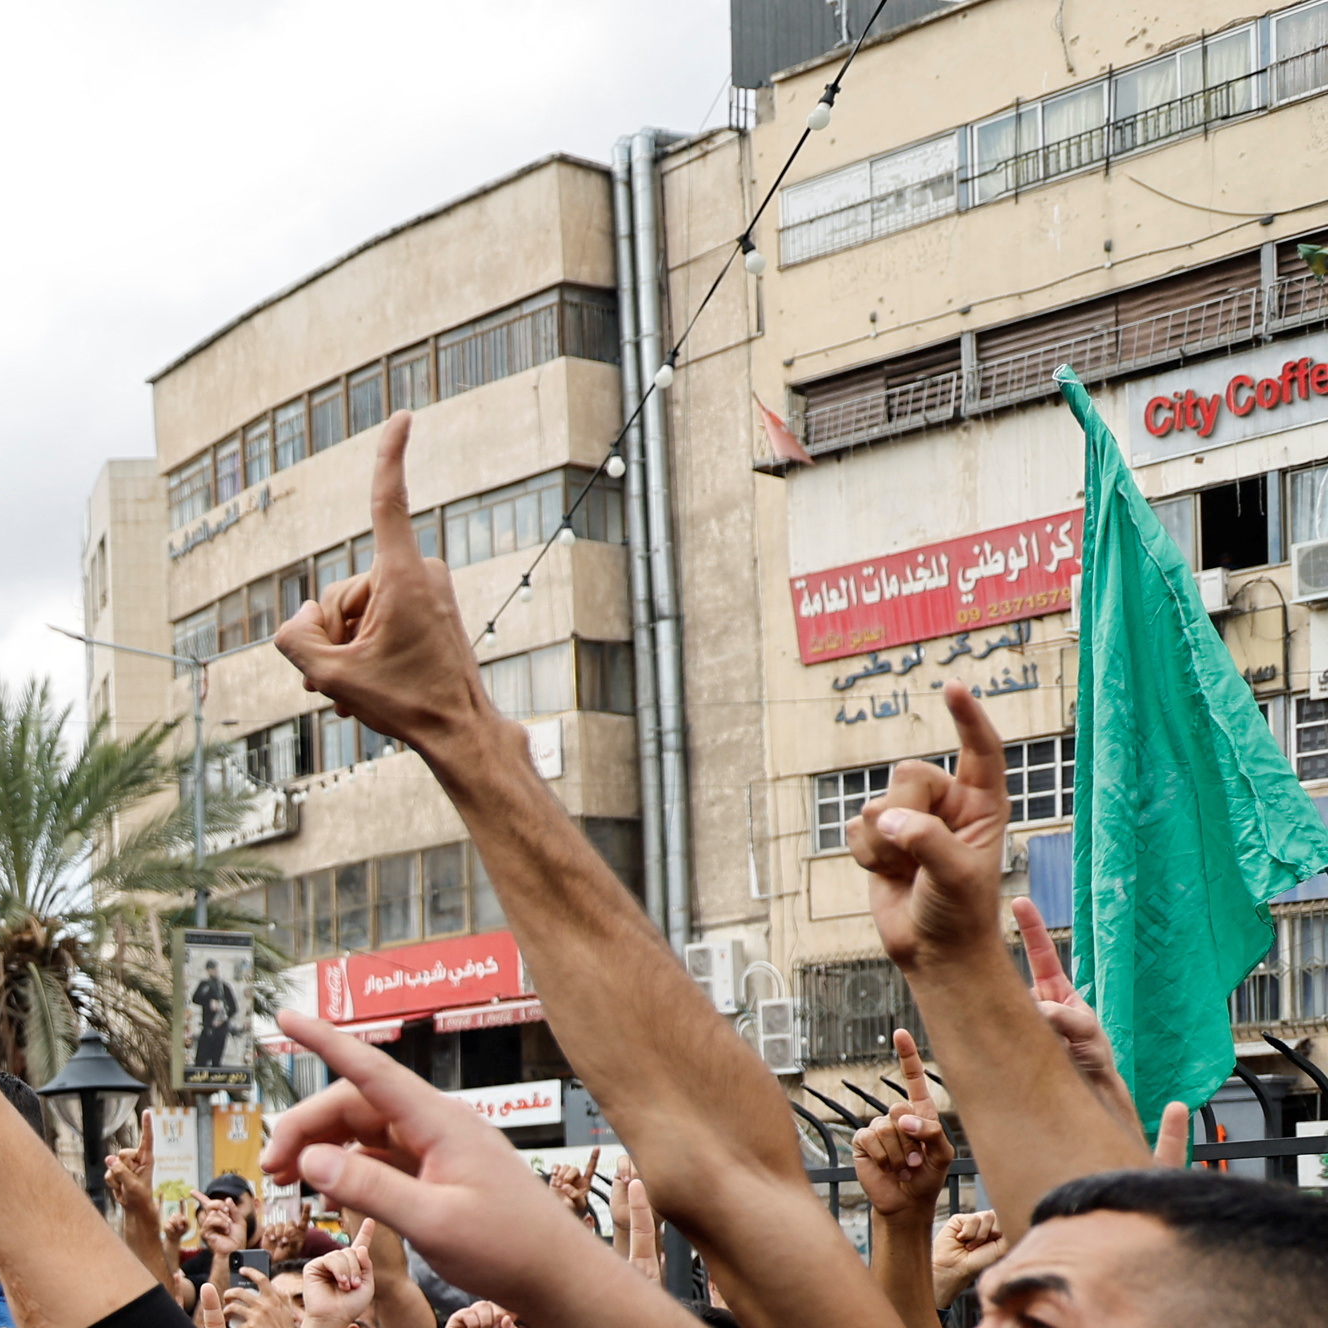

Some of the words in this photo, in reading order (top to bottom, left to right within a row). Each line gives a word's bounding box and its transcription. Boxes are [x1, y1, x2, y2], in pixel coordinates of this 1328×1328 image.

[1144, 388, 1221, 438] City
[861, 552, 950, 605] للخدمات
[956, 530, 1041, 605] الوطني
[794, 576, 858, 618] العامة
[956, 606, 982, 624] 09
[364, 971, 404, 996] الدوار
[405, 959, 447, 989] شوب
[447, 955, 500, 988] كوفي
